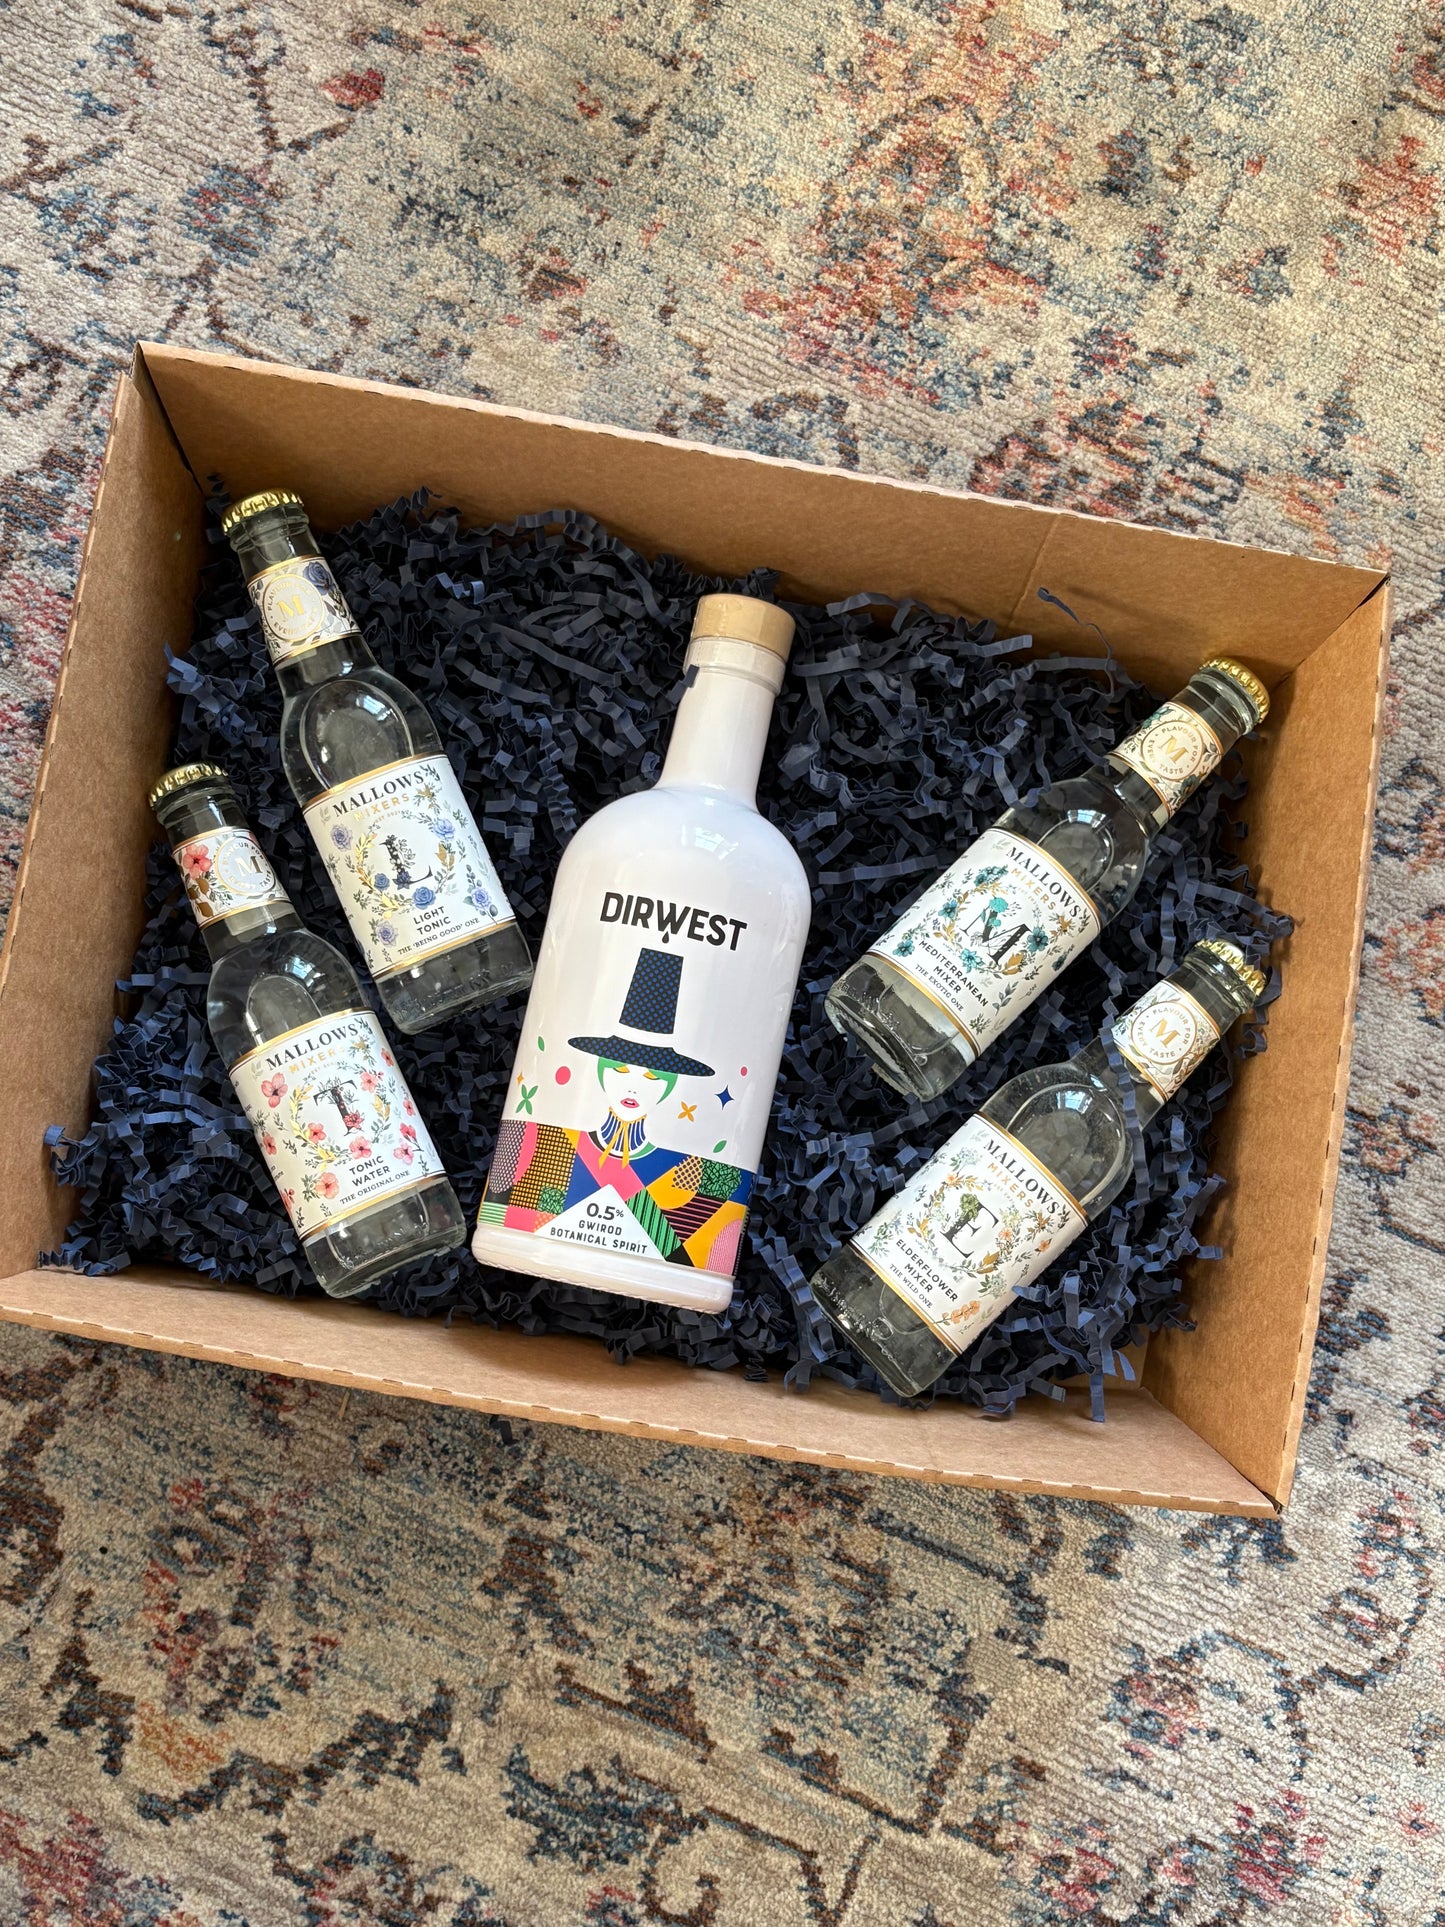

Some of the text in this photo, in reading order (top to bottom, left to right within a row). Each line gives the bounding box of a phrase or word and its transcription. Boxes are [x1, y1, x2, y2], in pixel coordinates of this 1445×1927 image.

[277, 595, 305, 622] M
[1158, 735, 1189, 764] M
[1161, 726, 1199, 762] FLAVOUR FOR
[332, 770, 424, 817] MALLOWS
[353, 793, 410, 821] MIXERS
[235, 855, 263, 877] M
[1005, 846, 1081, 918] MALLOWS
[1011, 868, 1056, 911] MIXERS
[413, 906, 446, 925] LIGHT
[416, 916, 452, 935] TONIC
[600, 891, 748, 951] DIRWEST
[397, 944, 413, 956] THE
[464, 917, 481, 927] ONE
[915, 964, 965, 1012] THE EXOTIC ONE
[918, 940, 989, 1007] MEDITERRANEAN
[933, 966, 962, 993] MIXER
[1149, 1018, 1181, 1048] M
[1152, 1006, 1191, 1045] FLAVOUR FOR
[265, 1023, 359, 1071] MALLOWS
[1149, 1048, 1176, 1059] TASTE
[349, 1155, 385, 1175] TONIC
[351, 1165, 391, 1187] WATER
[983, 1139, 1060, 1214] MALLOWS
[340, 1170, 411, 1205] THE ORIGINAL ONE
[987, 1162, 1034, 1208] MIXERS
[578, 1219, 622, 1236] GWIROD
[586, 1202, 624, 1221] 0.5%
[550, 1227, 648, 1254] BOTANICAL SPIRIT
[889, 1264, 933, 1308] THE WILD ONE
[895, 1239, 959, 1302] ELDERFLOWER
[904, 1263, 933, 1293] MIXER
